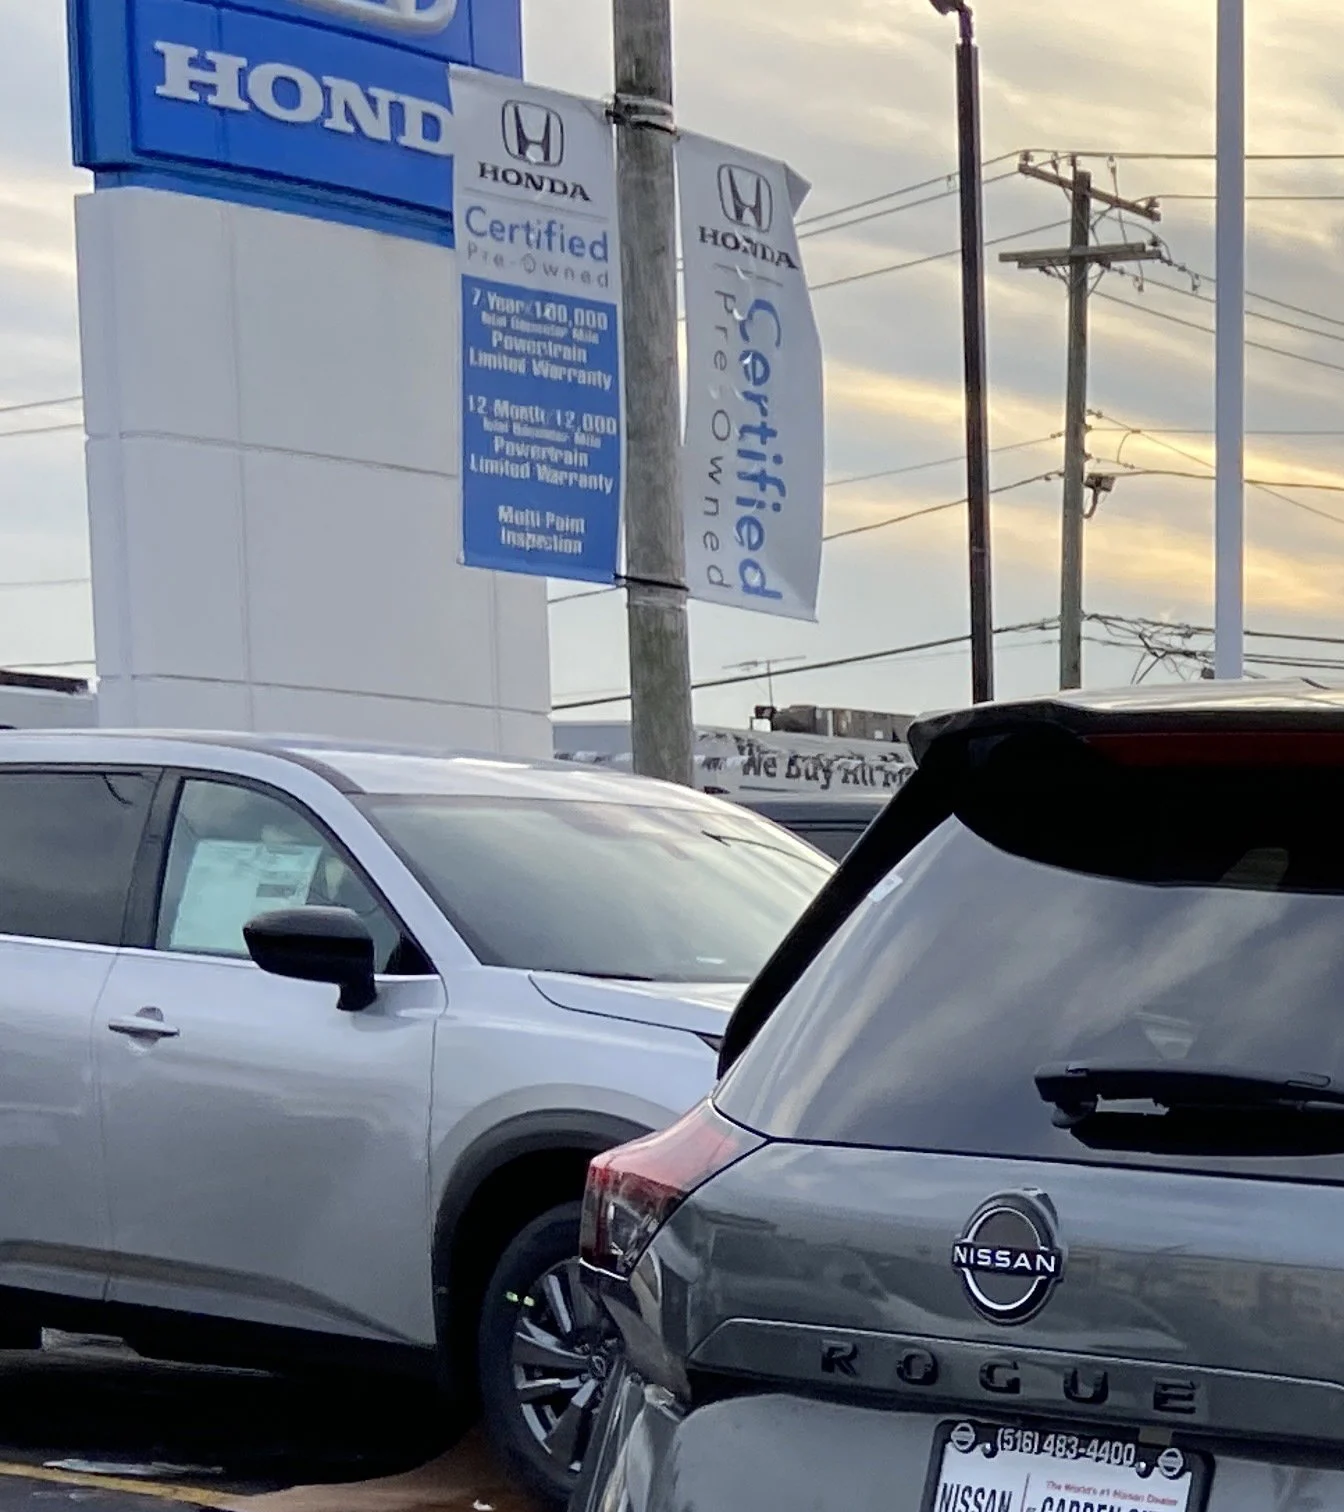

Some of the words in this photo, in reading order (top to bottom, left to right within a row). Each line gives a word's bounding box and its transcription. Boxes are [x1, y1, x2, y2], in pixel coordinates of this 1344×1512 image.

[154, 40, 453, 156] HOND
[478, 161, 592, 202] HONDA
[465, 205, 608, 263] Certified
[699, 225, 799, 270] HONDA
[467, 240, 609, 289] Pre-Owned
[472, 287, 482, 306] 7
[492, 330, 588, 364] Powertrain
[469, 347, 527, 375] Limited
[532, 358, 613, 391] Warranty
[469, 394, 488, 415] 12
[494, 436, 589, 468] Powertrain
[735, 299, 787, 600] Certified
[470, 453, 530, 480] Limited
[536, 463, 614, 495] Warranty
[501, 526, 583, 555] Inspection
[733, 734, 778, 778] We
[785, 751, 835, 790] Buy
[953, 1244, 1057, 1274] NISSAN
[819, 1340, 1197, 1414] ROGUE
[997, 1427, 1039, 1455] (516)
[1043, 1433, 1136, 1467] 483-4400
